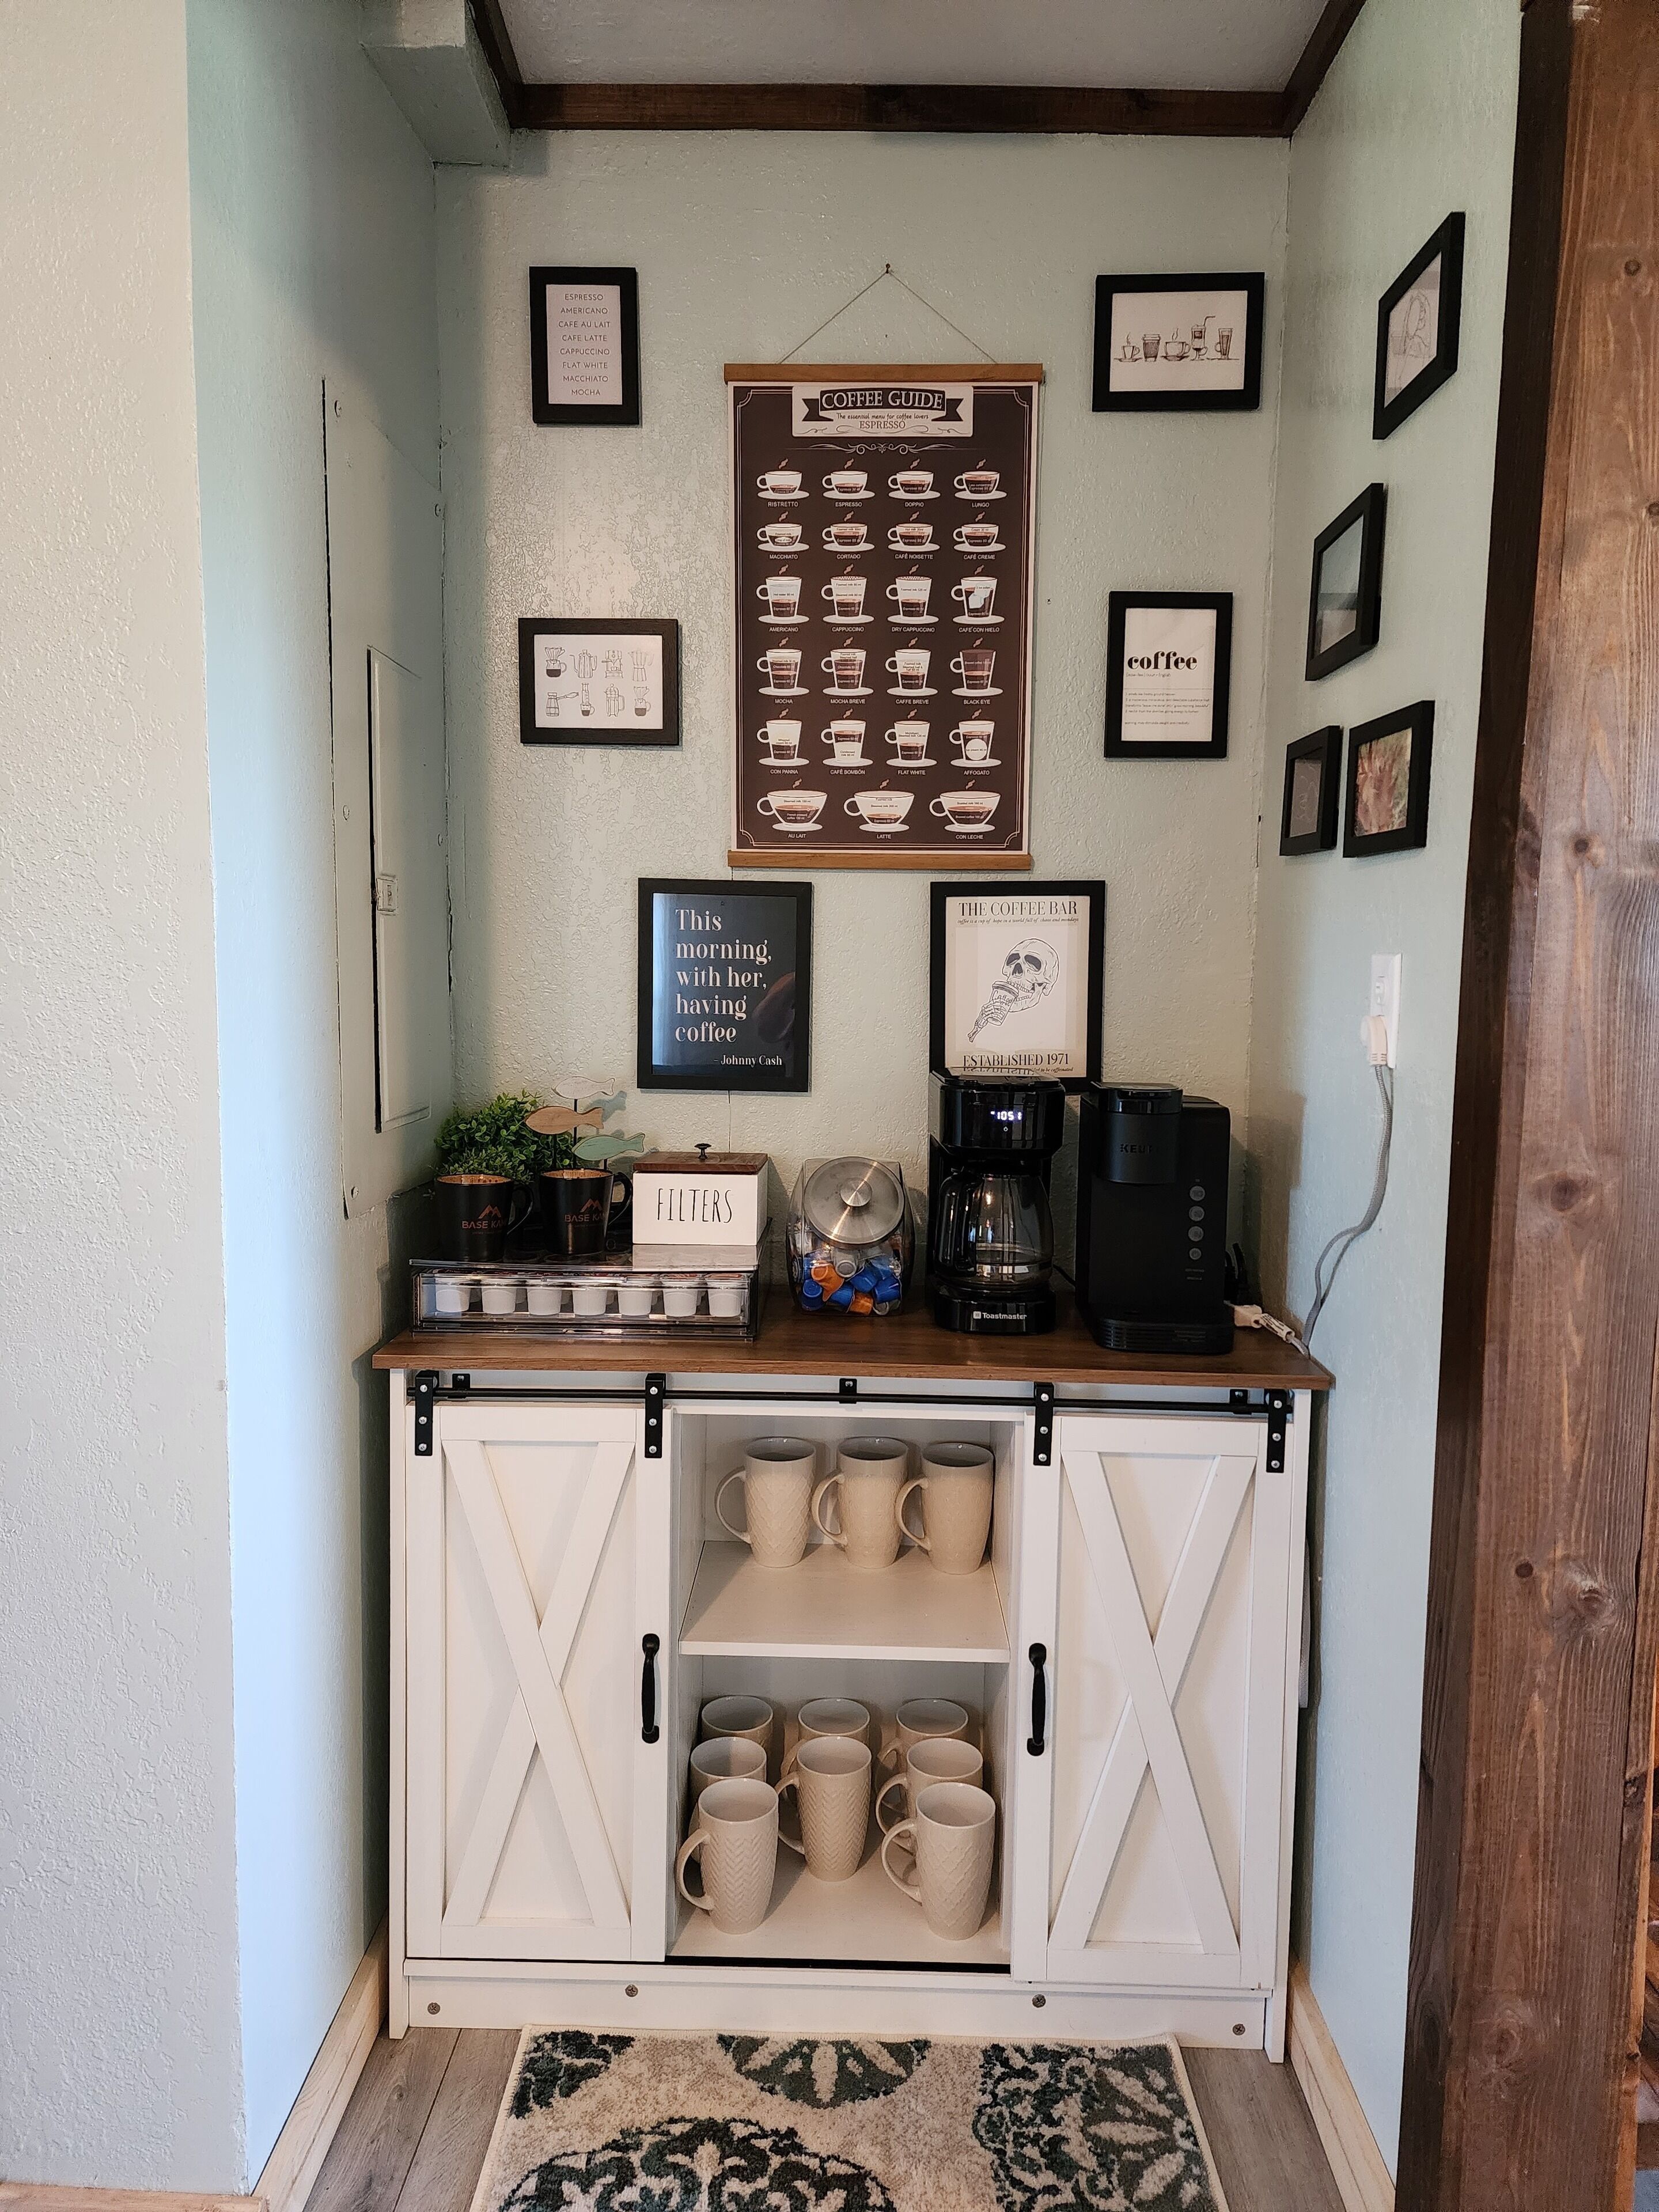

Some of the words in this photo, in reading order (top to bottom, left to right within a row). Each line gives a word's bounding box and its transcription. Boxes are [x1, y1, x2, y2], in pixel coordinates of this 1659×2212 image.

[822, 391, 882, 409] COFFEE
[888, 391, 943, 409] GUIDE
[859, 421, 906, 429] ESPRESSO
[1127, 651, 1198, 670] coffee
[959, 902, 987, 916] THE
[991, 902, 1046, 916] COFFEE
[1050, 900, 1077, 915] BAR
[675, 909, 722, 931] This
[676, 939, 772, 965] morning,
[676, 966, 721, 987] with
[727, 966, 767, 990] her,
[676, 993, 747, 1021] having
[675, 1021, 737, 1043] coffee
[721, 1055, 757, 1067] Johnny
[759, 1055, 782, 1066] Cash
[963, 1054, 1043, 1066] ESTABLISHED
[1047, 1053, 1069, 1065] 1971
[657, 1188, 732, 1224] FILTERS
[462, 1221, 488, 1229] BASE
[565, 1214, 590, 1222] BASE
